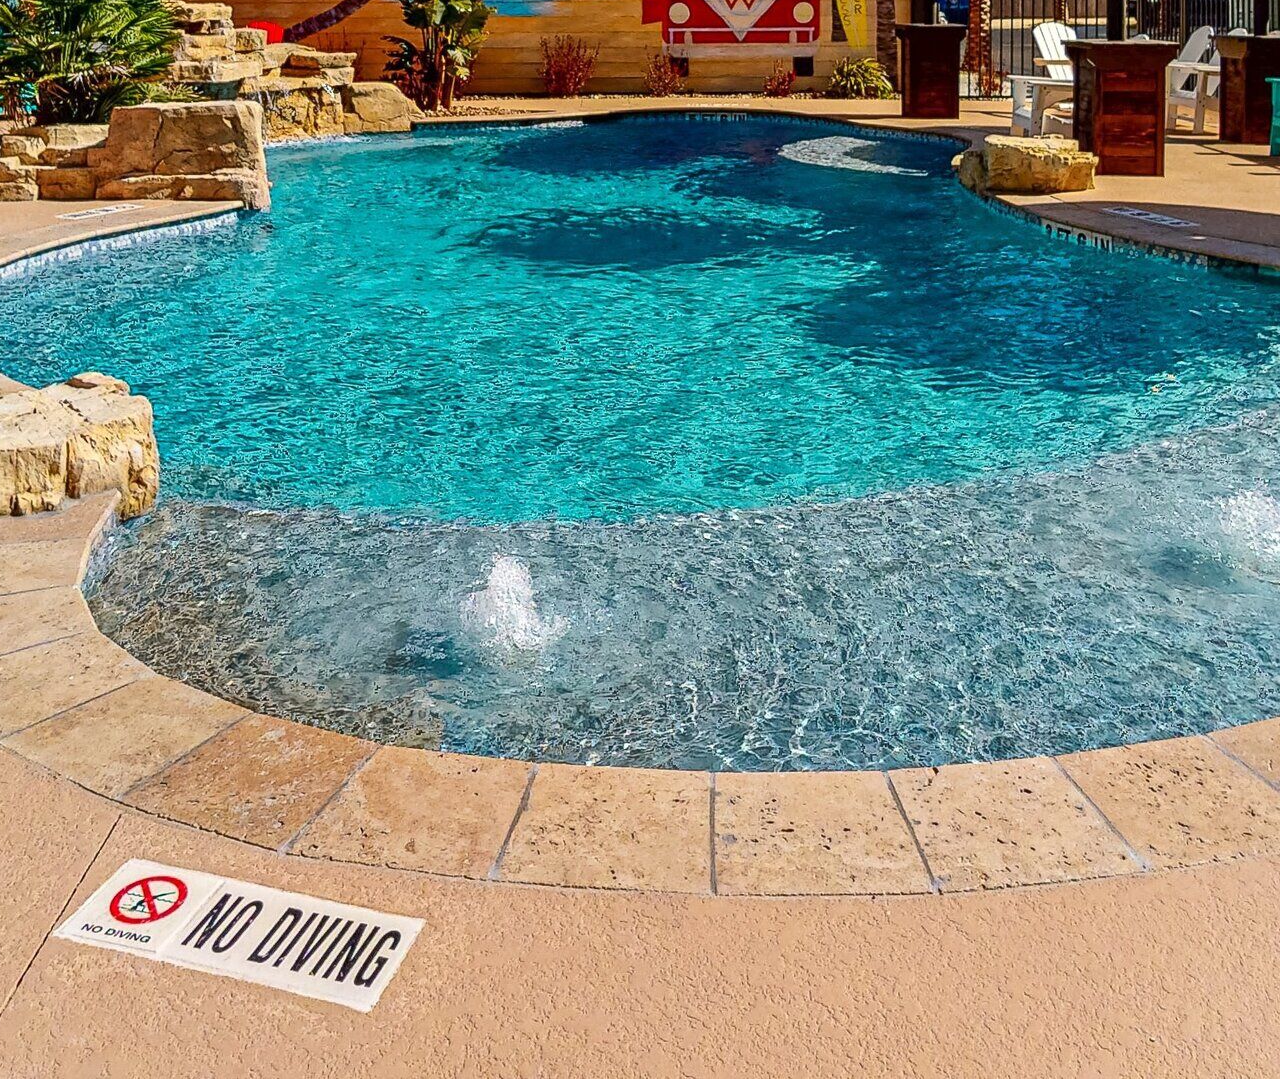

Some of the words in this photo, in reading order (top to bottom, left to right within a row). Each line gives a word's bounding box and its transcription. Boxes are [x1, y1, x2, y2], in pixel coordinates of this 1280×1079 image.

[81, 923, 103, 933] NO
[104, 928, 152, 943] DIVING
[181, 893, 264, 954] NO
[247, 907, 402, 988] DIVING
